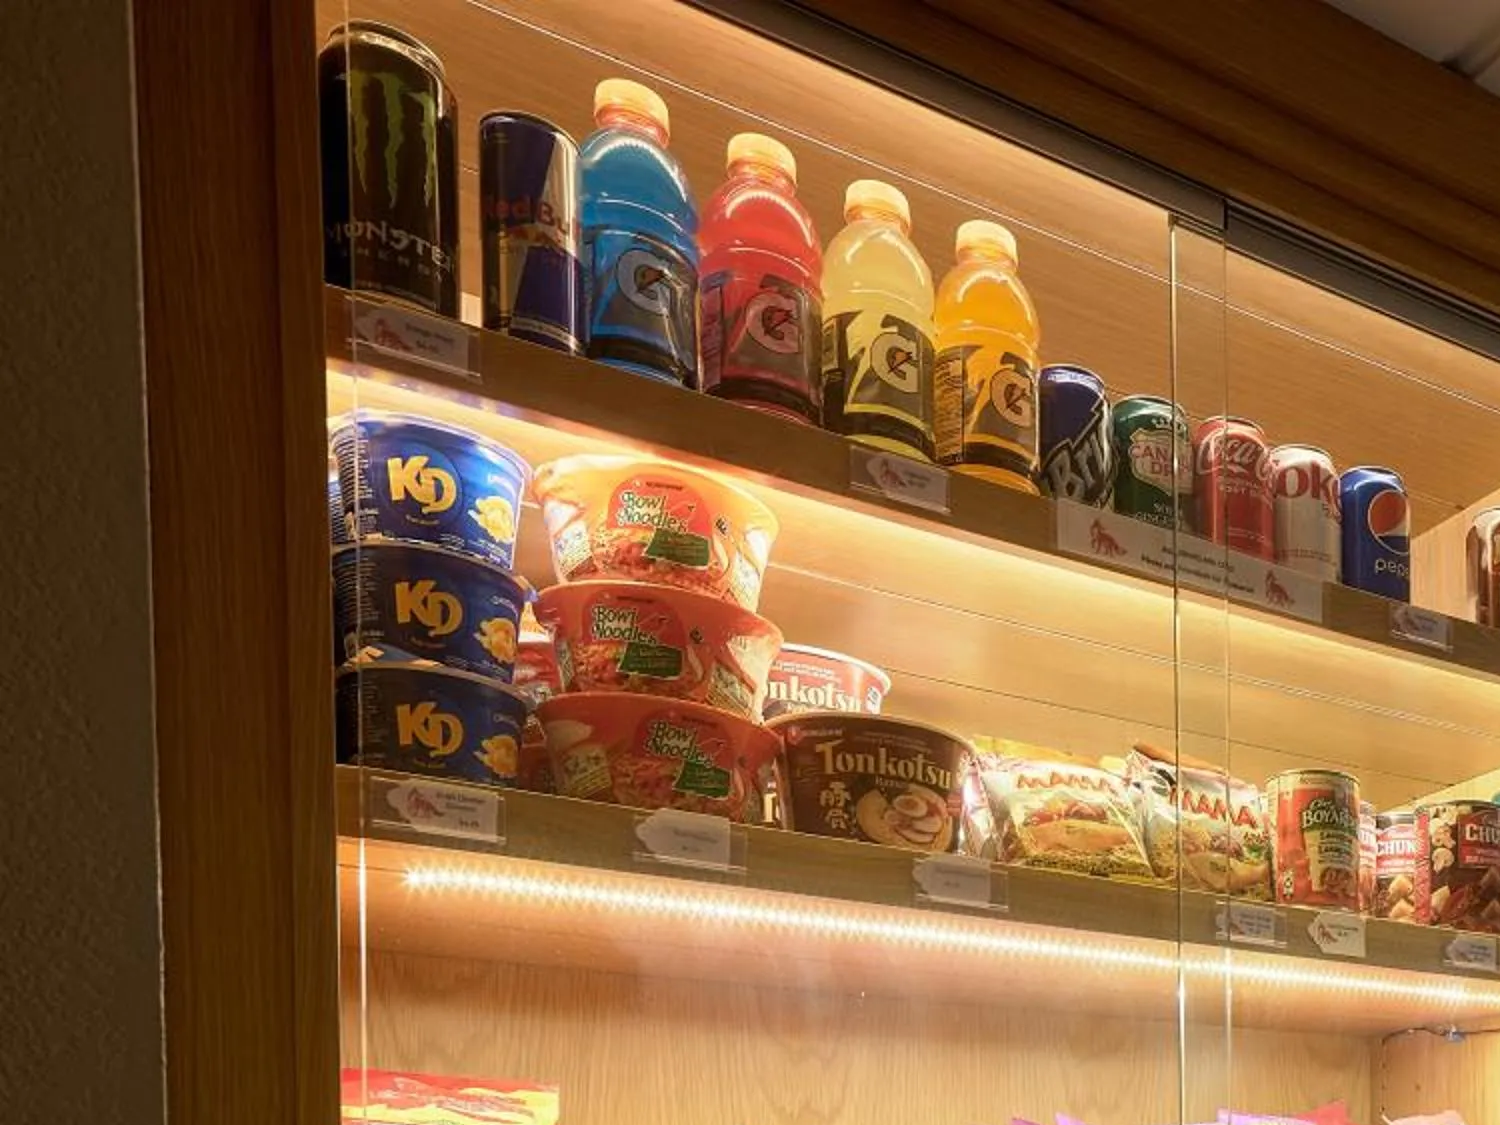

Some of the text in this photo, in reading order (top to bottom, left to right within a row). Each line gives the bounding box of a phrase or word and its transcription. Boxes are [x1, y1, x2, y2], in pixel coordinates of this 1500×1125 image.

[387, 455, 457, 514] KD
[620, 491, 667, 511] Bowl
[395, 579, 463, 638] KD
[592, 605, 639, 624] Bowl
[768, 675, 862, 712] nkotsu
[396, 702, 464, 758] KD
[816, 739, 952, 790] Tonkotsu
